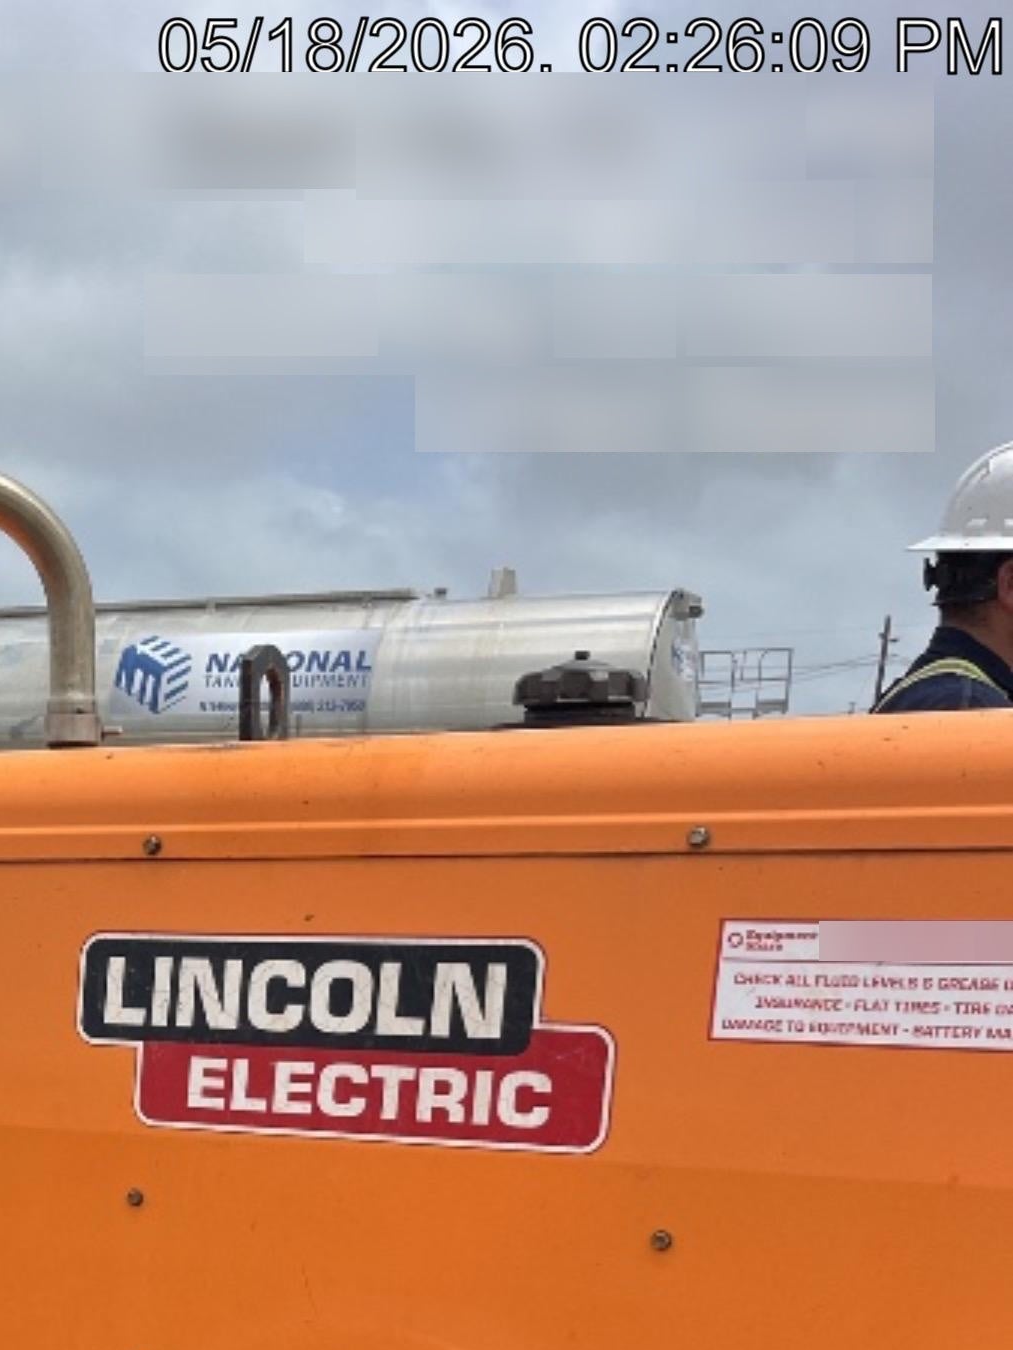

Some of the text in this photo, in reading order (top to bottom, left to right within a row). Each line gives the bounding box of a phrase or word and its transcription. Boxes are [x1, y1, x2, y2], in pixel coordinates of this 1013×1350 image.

[205, 650, 371, 672] NAONAL
[205, 674, 241, 688] TAN
[733, 973, 781, 986] CHECK
[785, 974, 809, 988] ALL
[814, 974, 859, 988] FLUID
[862, 976, 918, 989] LEVELS
[937, 977, 999, 992] GREASE
[102, 956, 508, 1039] LINCOLN
[755, 996, 843, 1012] INSURANCE
[853, 999, 889, 1012] FLAT
[895, 1001, 941, 1015] TIRES
[954, 1002, 991, 1015] TIRE
[722, 1019, 783, 1032] DAMAGE
[787, 1020, 805, 1033] TO
[808, 1022, 899, 1036] EQUIPMENT
[912, 1025, 982, 1039] BATTERY
[187, 1055, 552, 1128] ELECTRIC
